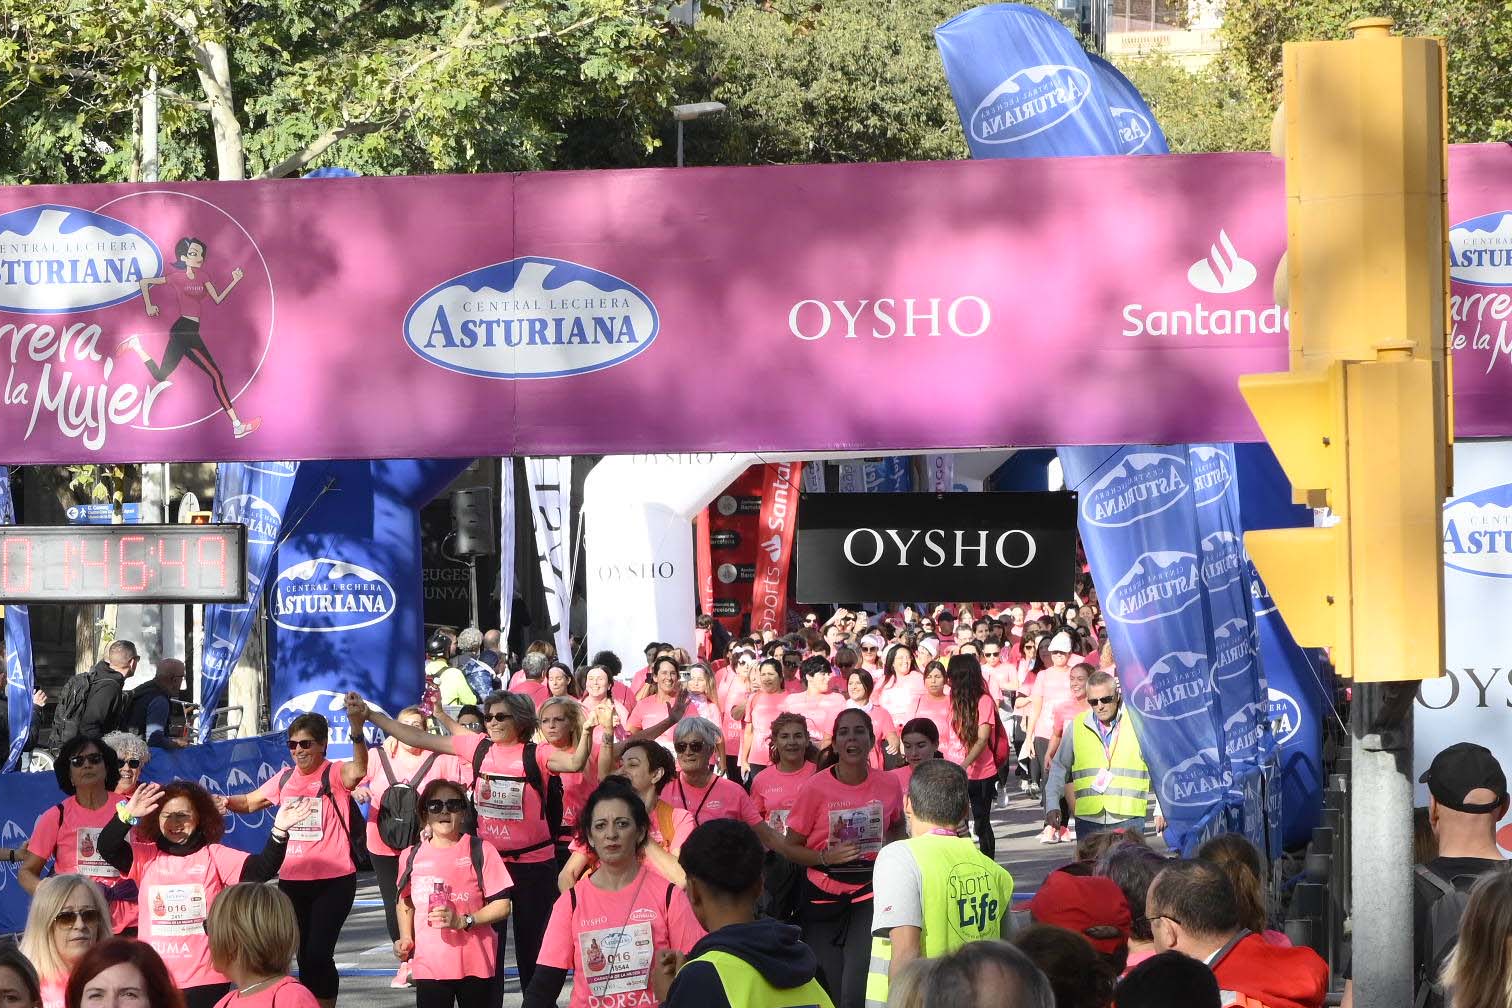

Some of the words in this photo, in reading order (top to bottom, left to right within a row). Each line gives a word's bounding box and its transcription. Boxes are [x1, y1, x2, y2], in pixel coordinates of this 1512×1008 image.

[65, 239, 137, 253] LECHERA
[462, 298, 545, 313] CENTRAL
[549, 296, 631, 312] LECHERA
[789, 295, 992, 341] OYSHO
[423, 303, 640, 349] ASTURIANA
[1122, 303, 1291, 338] Santand
[4, 367, 29, 406] la
[24, 355, 174, 452] Mujer
[843, 527, 1038, 569] OYSHO
[274, 586, 388, 616] ASTURIANA
[286, 583, 330, 593] CENTRAL
[333, 583, 382, 592] LECHERA
[492, 791, 507, 799] 016
[949, 871, 992, 900] Sport
[168, 904, 187, 913] 016
[580, 915, 608, 927] OYSHO
[957, 892, 998, 932] Life
[608, 951, 631, 965] 016
